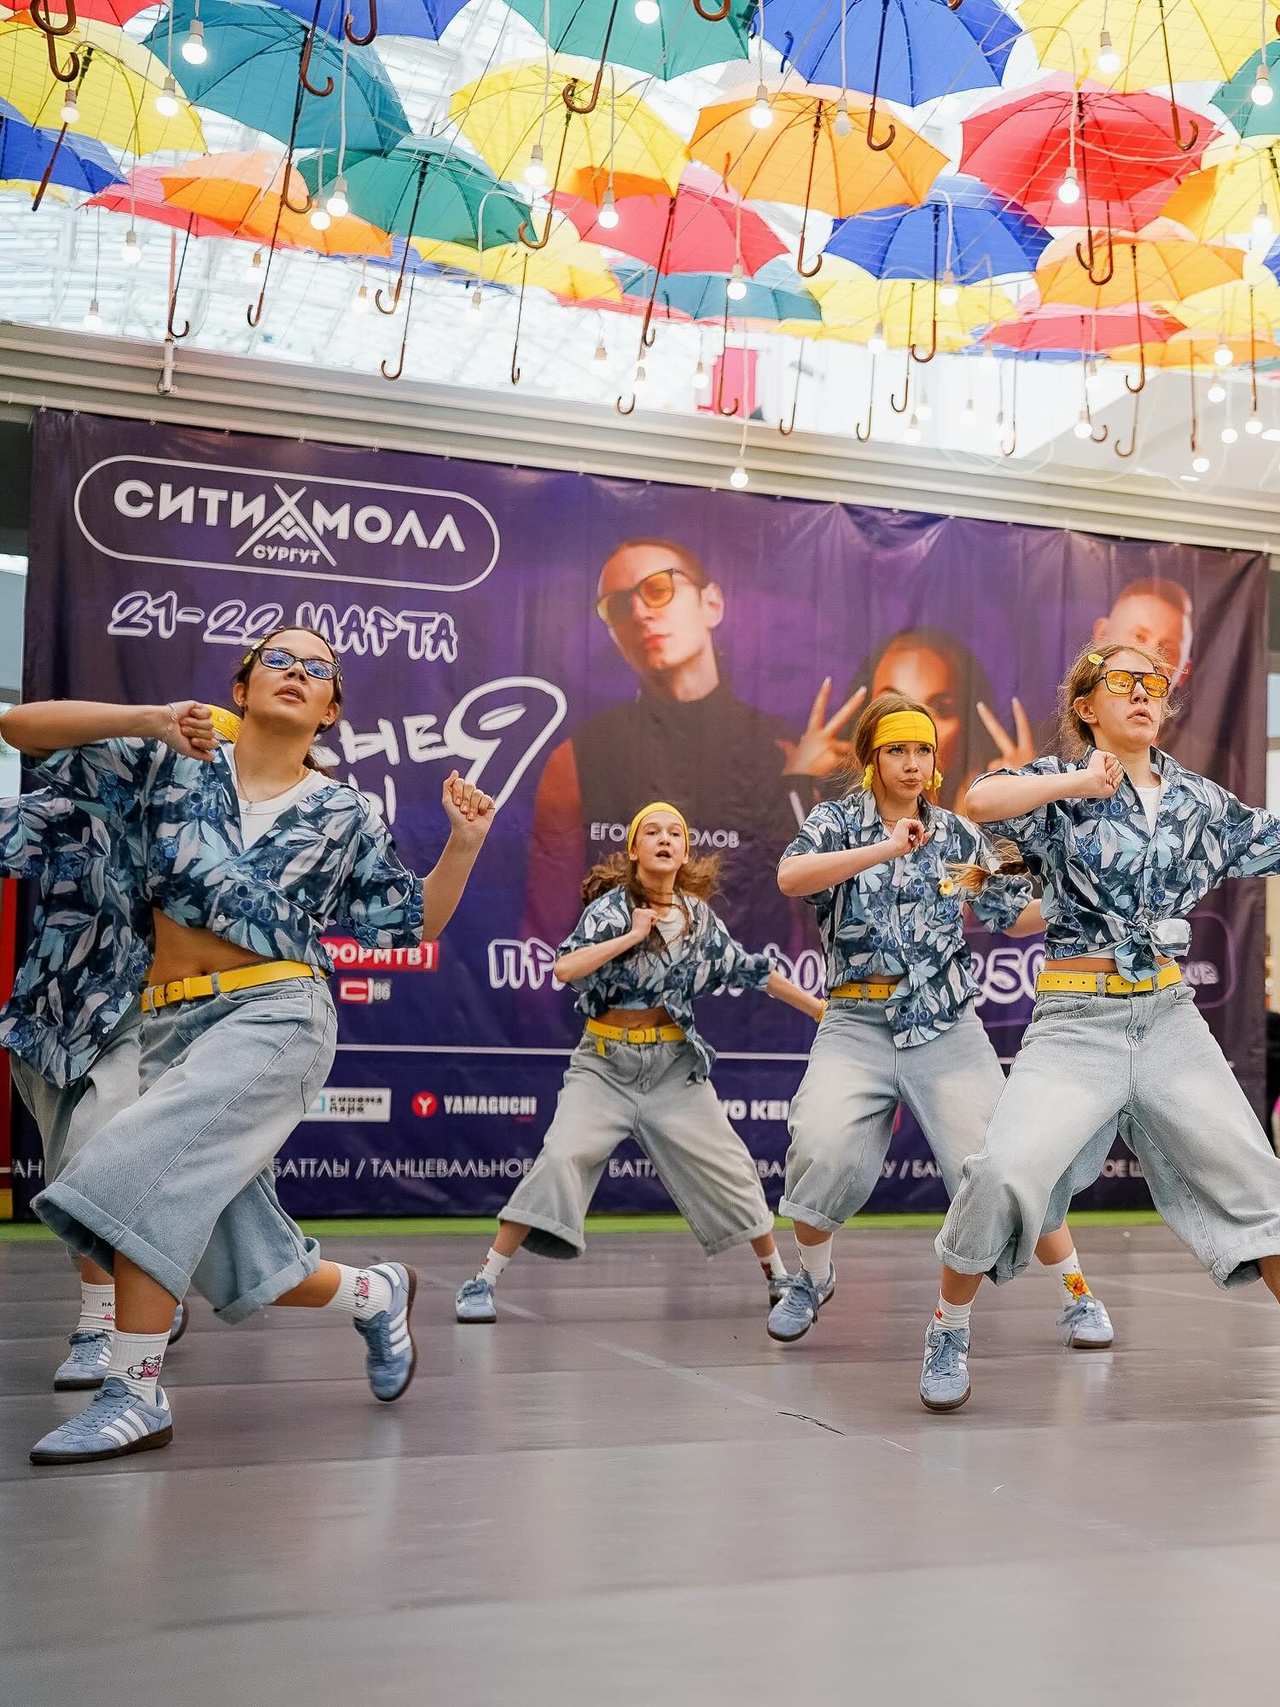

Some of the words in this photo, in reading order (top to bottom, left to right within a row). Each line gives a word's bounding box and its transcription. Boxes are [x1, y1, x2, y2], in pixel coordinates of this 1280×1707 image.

[113, 478, 266, 530] СИТИ
[311, 500, 467, 553] МОЛЛ
[252, 543, 320, 566] СУРГУТ
[107, 590, 284, 644] 21-22
[295, 602, 459, 664] МАРТА
[443, 1095, 538, 1115] YAMAGUCHI
[370, 1157, 534, 1179] ТАНЦЕВАЛЬНОЕ
